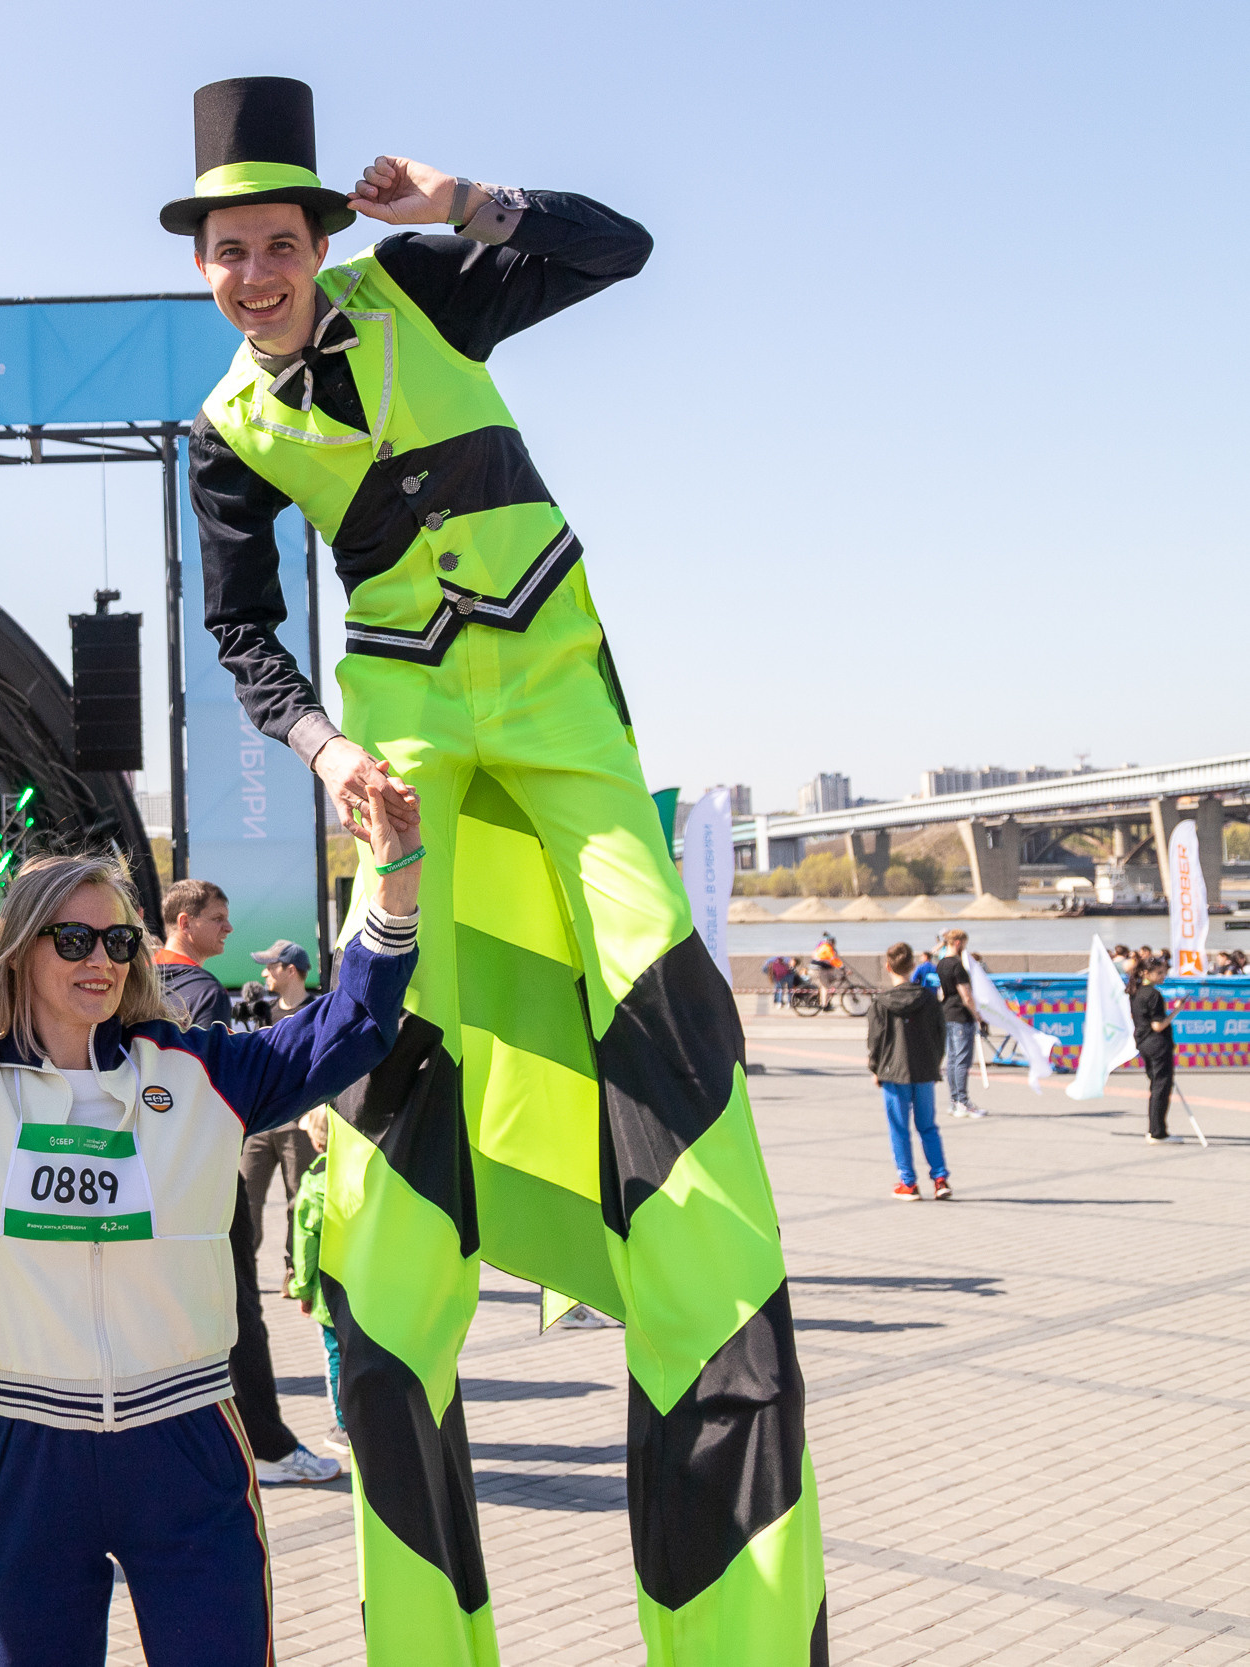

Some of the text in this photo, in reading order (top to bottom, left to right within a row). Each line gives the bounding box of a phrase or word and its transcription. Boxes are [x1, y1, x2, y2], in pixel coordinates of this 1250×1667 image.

[1039, 1021, 1074, 1037] МЫ
[1172, 1019, 1216, 1034] ТЕБЯ
[55, 1138, 74, 1146] СБЕР
[31, 1165, 119, 1205] 0889
[100, 1222, 117, 1232] 4,2
